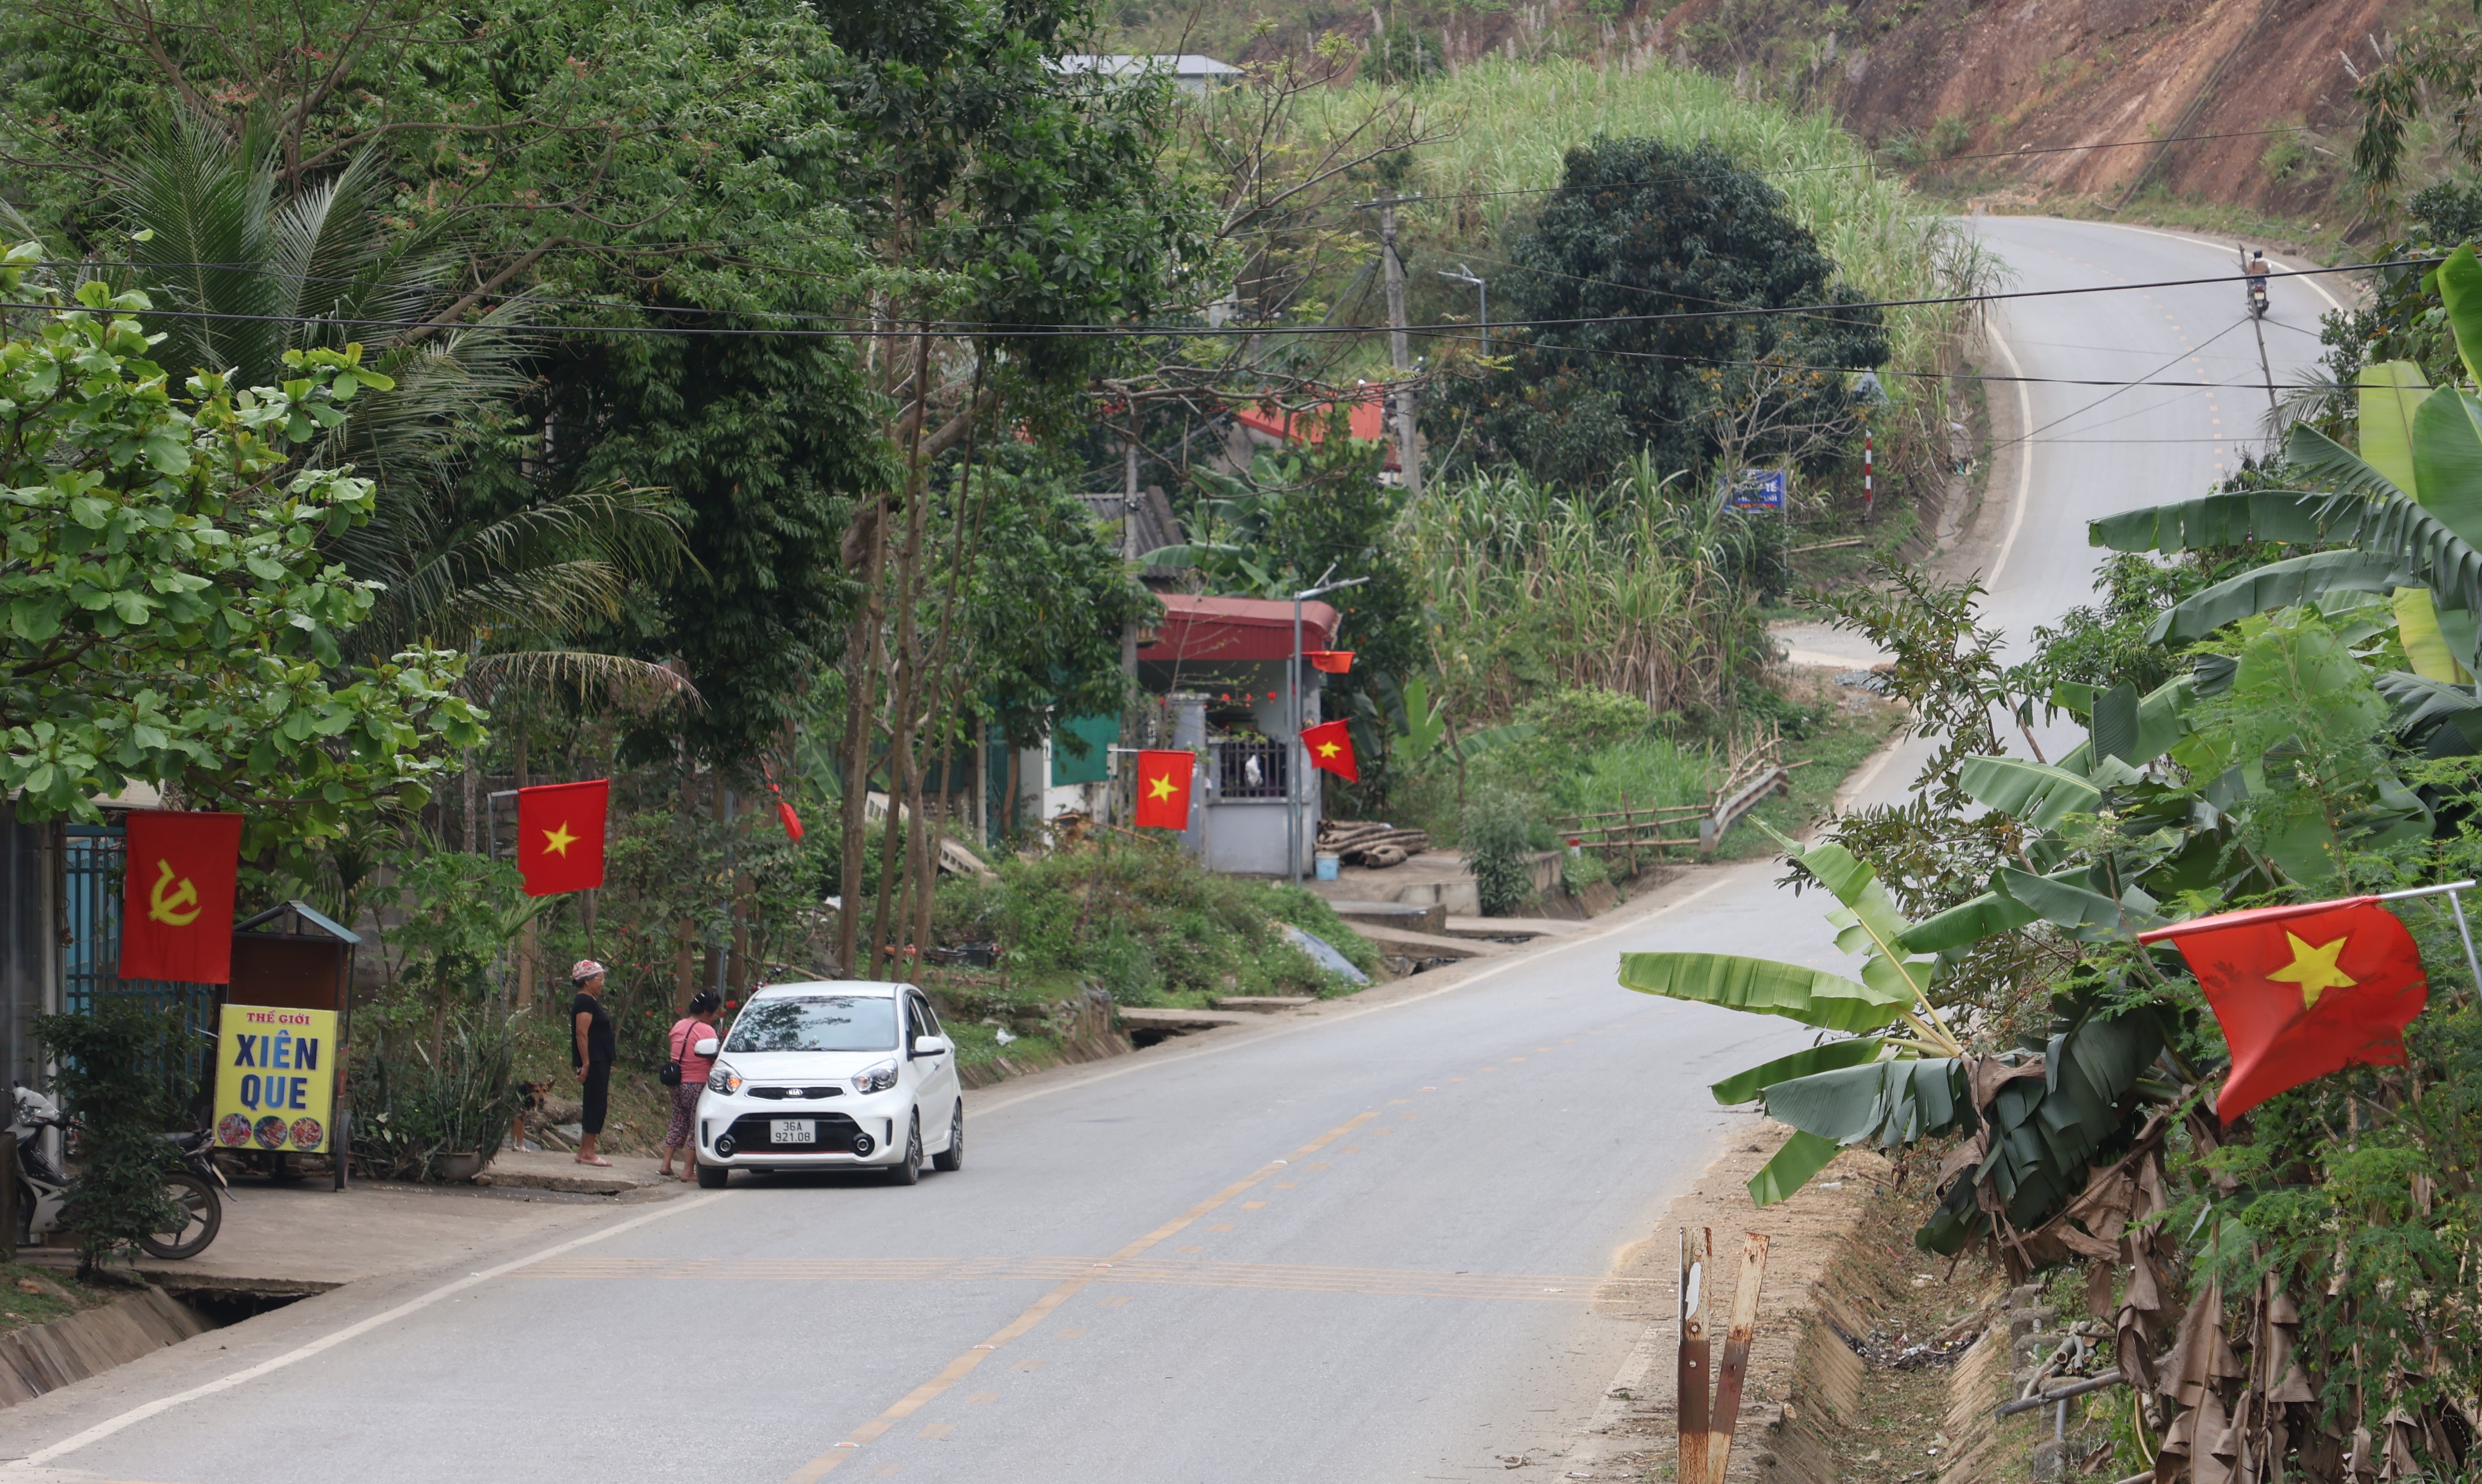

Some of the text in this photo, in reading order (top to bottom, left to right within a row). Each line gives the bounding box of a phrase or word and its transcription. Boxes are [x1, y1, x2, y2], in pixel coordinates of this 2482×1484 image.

[247, 1010, 310, 1025] THẾ GIỚI
[234, 1030, 318, 1070] XIÊN
[240, 1074, 307, 1111] QUE
[783, 1122, 802, 1131] 36A
[775, 1132, 810, 1142] 921.08
